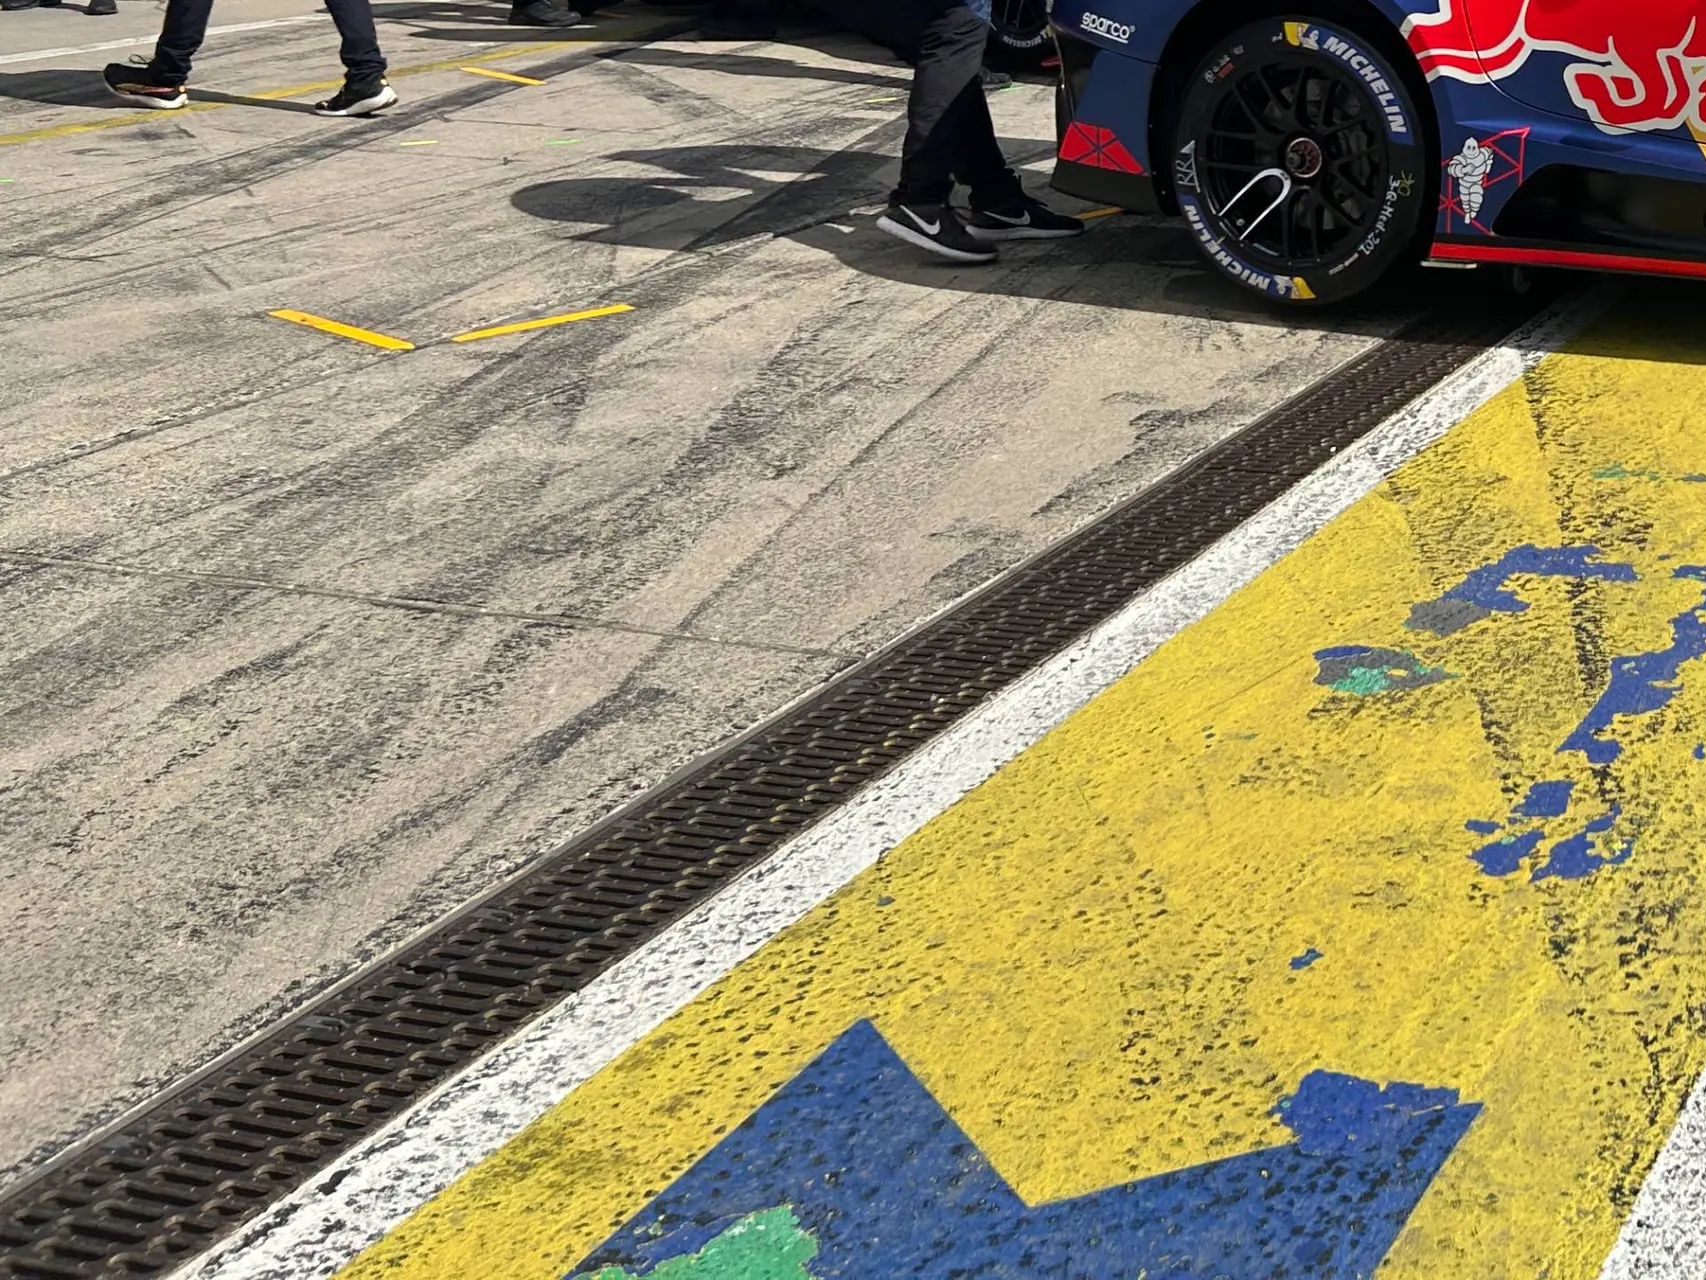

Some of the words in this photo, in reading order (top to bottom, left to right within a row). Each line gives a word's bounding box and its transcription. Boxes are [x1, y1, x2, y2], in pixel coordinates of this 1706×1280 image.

[1082, 11, 1131, 40] sparco
[1322, 35, 1408, 134] MICHELIN
[1184, 204, 1271, 291] MICHELIN
